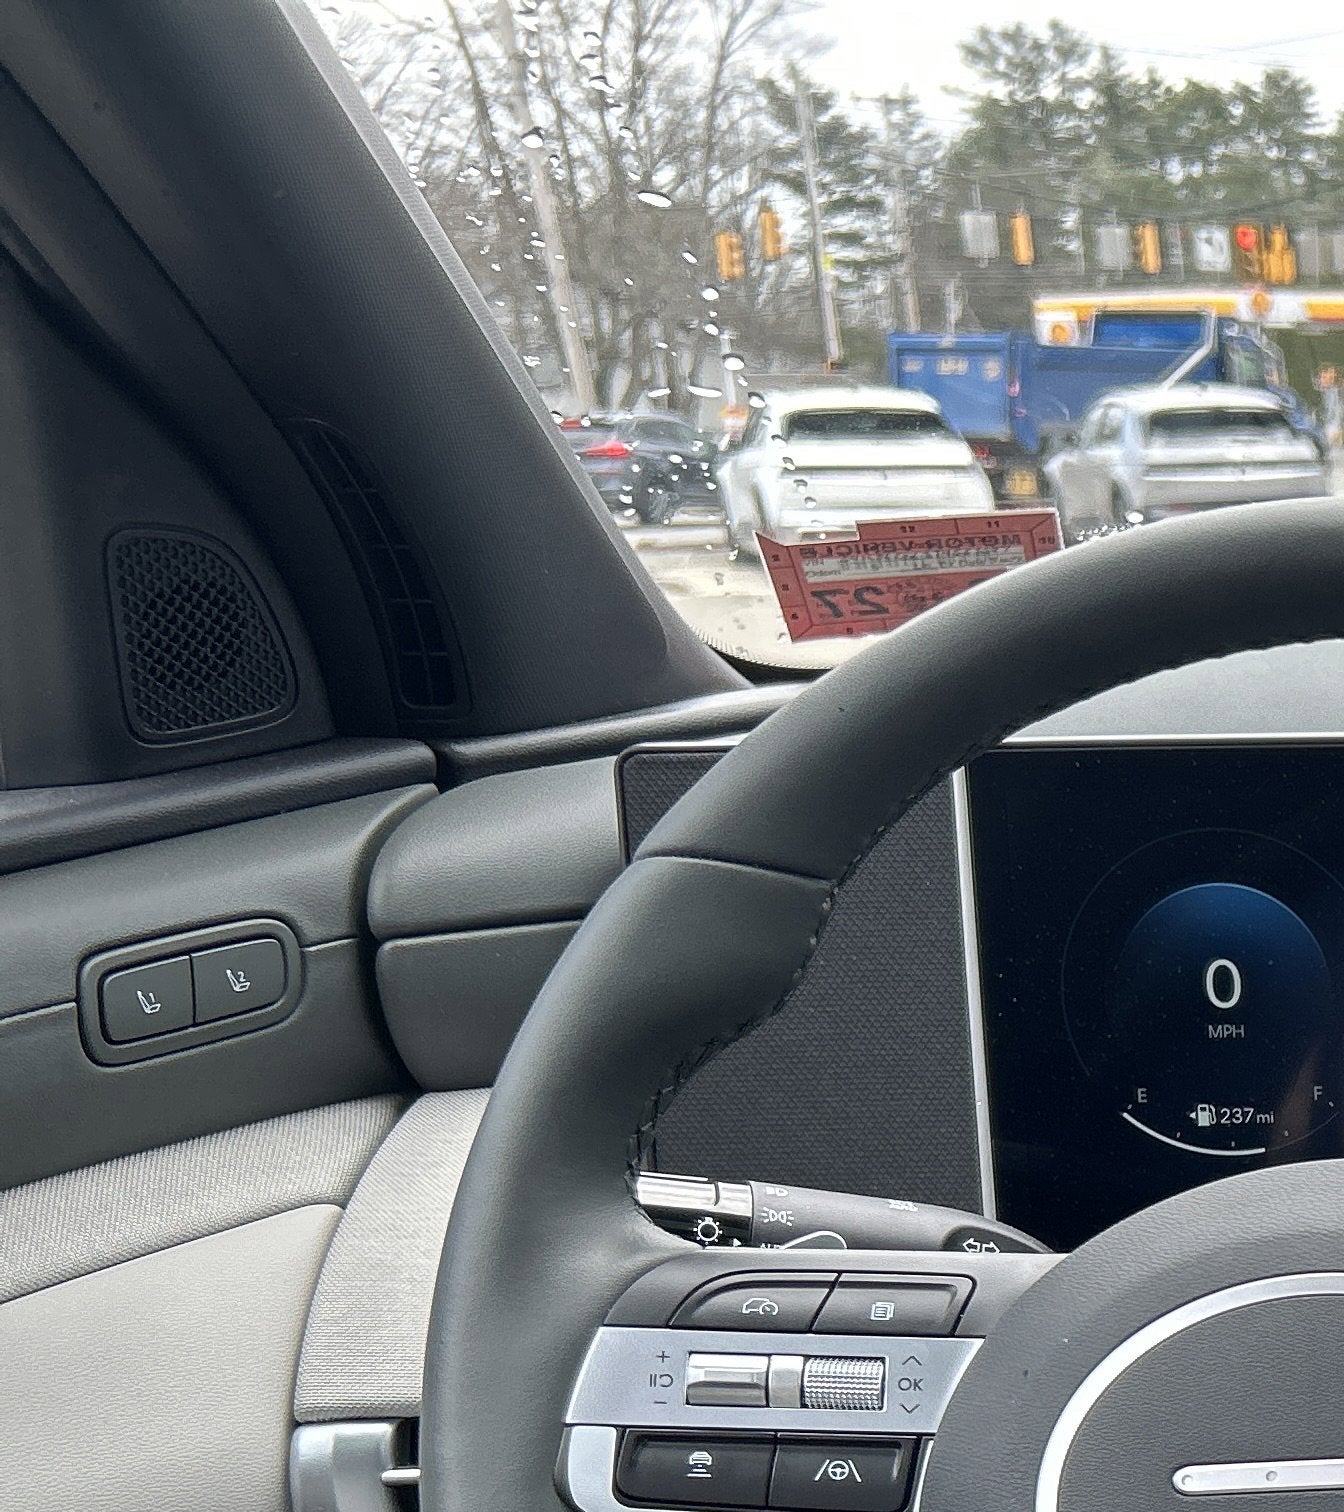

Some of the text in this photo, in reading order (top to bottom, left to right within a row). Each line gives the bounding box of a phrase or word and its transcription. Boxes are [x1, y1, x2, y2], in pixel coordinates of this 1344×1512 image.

[1205, 958, 1242, 1009] 0
[1208, 1024, 1245, 1039] MPH
[1137, 1087, 1148, 1103] E
[1313, 1085, 1323, 1101] F
[1219, 1107, 1275, 1125] 237 mi
[897, 1377, 924, 1392] OK
